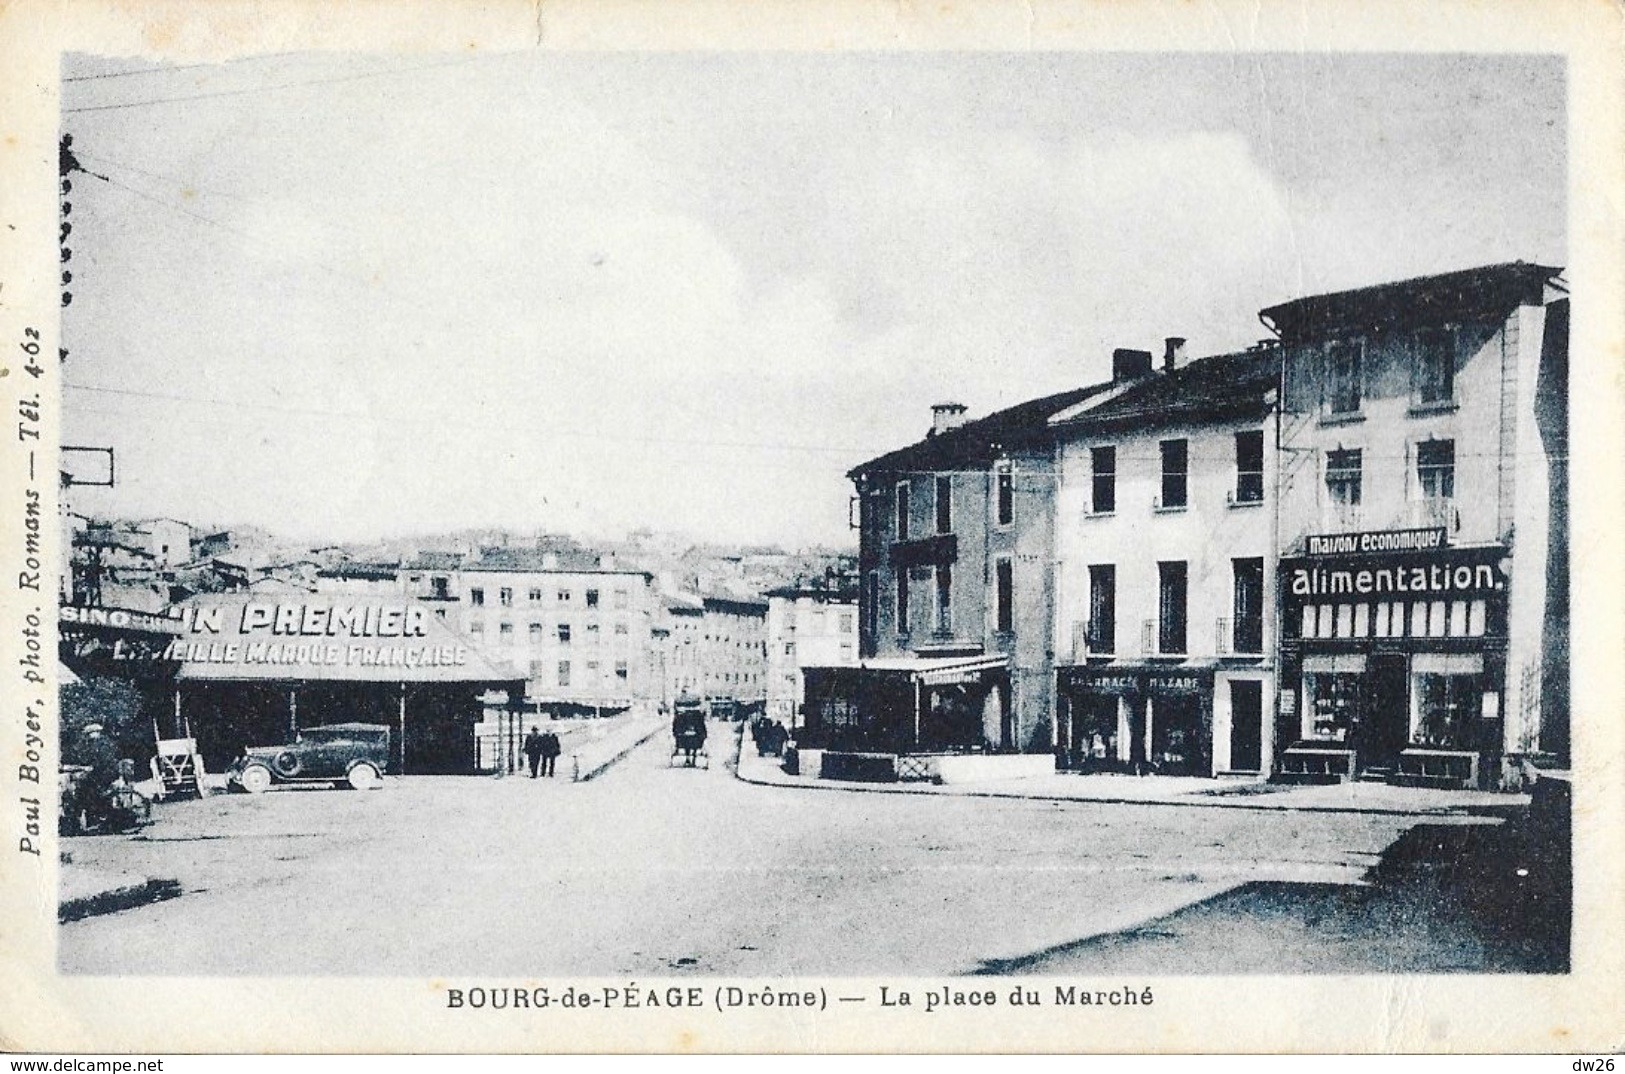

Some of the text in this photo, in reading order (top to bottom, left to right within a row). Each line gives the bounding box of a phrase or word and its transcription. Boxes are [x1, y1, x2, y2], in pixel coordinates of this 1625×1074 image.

[239, 603, 428, 637] PREMIER
[245, 644, 341, 666] MARQUE
[346, 646, 467, 669] FRANÇAISE
